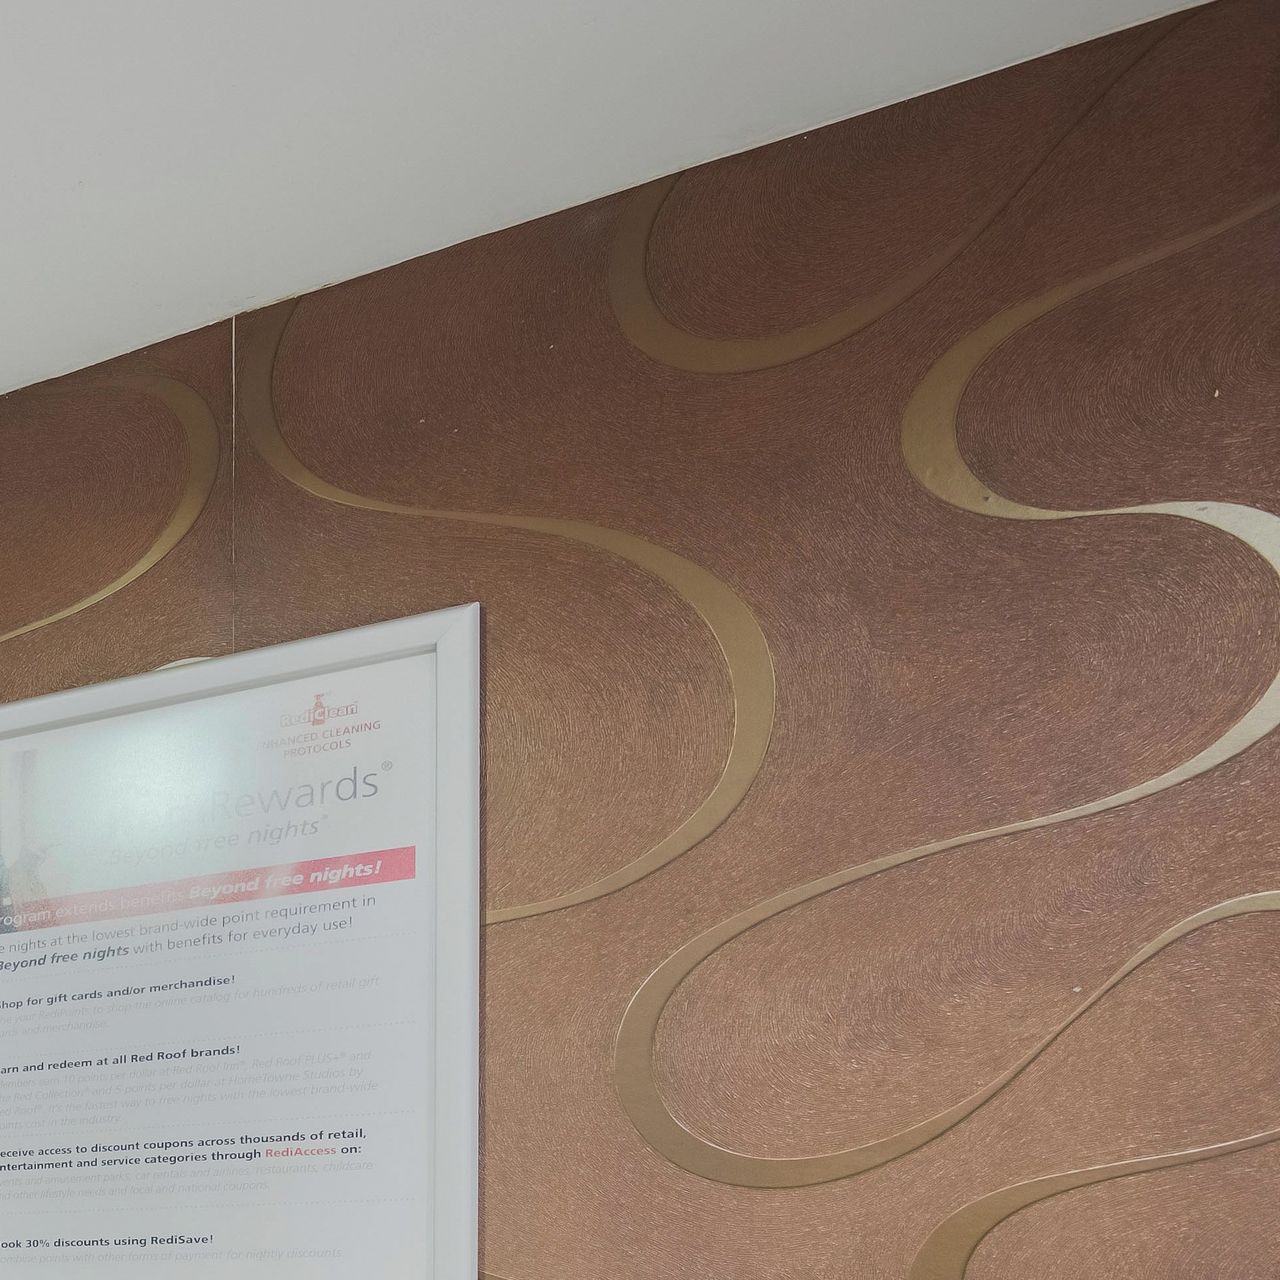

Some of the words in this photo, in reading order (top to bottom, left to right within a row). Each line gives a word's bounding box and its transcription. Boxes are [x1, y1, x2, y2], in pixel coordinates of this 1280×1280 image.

[321, 720, 381, 739] CLEANING
[284, 739, 351, 759] PROTOCOLS
[190, 877, 260, 900] Beyond
[265, 873, 304, 890] free
[309, 860, 382, 884] nights!
[9, 937, 47, 956] nights
[92, 926, 135, 943] lowest
[140, 916, 217, 936] brand-wide
[222, 910, 260, 928] point
[265, 897, 356, 919] requirement
[51, 952, 78, 964] free
[82, 945, 129, 963] nights
[167, 933, 223, 951] benefits
[253, 920, 317, 940] everyday
[323, 916, 353, 931] use!
[46, 994, 68, 1006] gift
[71, 990, 103, 1001] cards
[107, 985, 146, 998] and/or
[149, 975, 235, 993] merchandise!
[22, 1062, 44, 1072] and
[48, 1059, 92, 1070] redeem
[131, 1053, 153, 1063] Red
[157, 1049, 187, 1060] Roof
[191, 1045, 240, 1058] brands!
[38, 1147, 72, 1156] access
[91, 1141, 140, 1153] discount
[143, 1139, 193, 1151] coupons
[197, 1137, 236, 1147] across
[240, 1132, 305, 1144] thousands
[328, 1128, 367, 1140] retail,
[76, 1157, 98, 1168] and
[101, 1156, 141, 1166] service
[144, 1152, 207, 1165] categories
[211, 1148, 261, 1161] through
[265, 1146, 337, 1158] RediAccess
[54, 1238, 110, 1247] discounts
[114, 1236, 147, 1247] using
[150, 1234, 213, 1245] RediSave!
